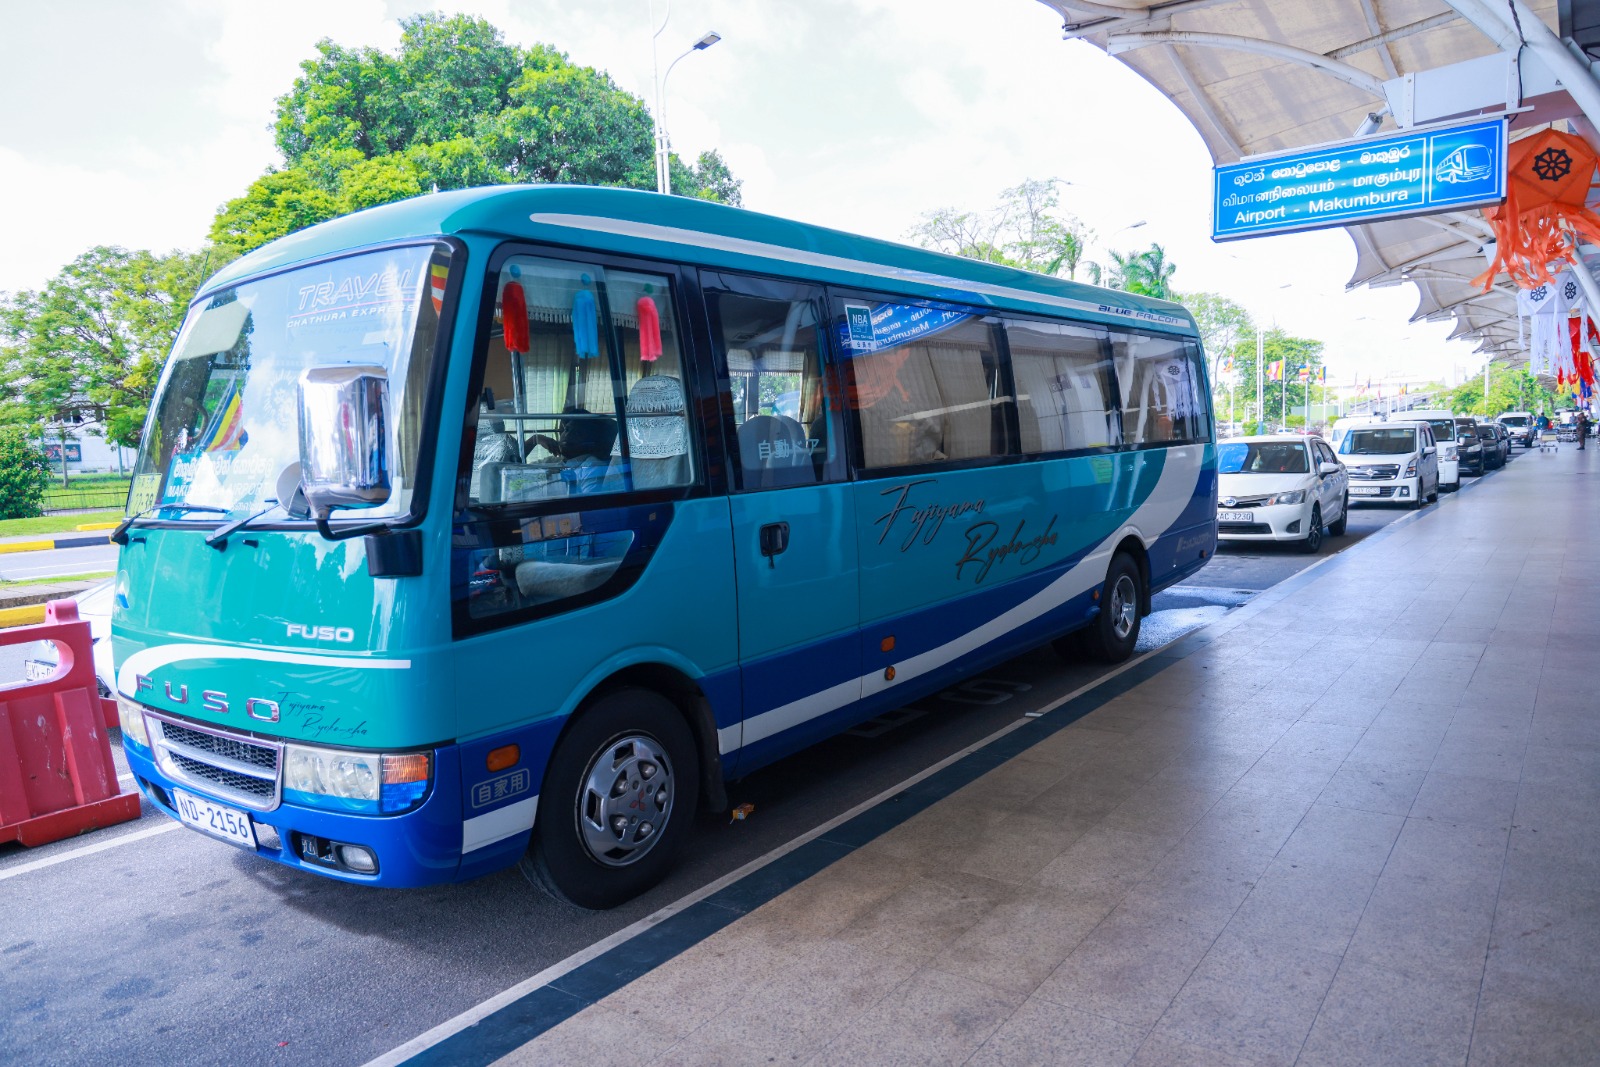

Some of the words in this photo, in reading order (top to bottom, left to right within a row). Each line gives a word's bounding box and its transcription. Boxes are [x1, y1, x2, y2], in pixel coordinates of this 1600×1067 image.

[1234, 205, 1286, 224] Airport
[1308, 190, 1409, 214] Makumbura
[298, 269, 417, 311] TRAVEL
[286, 311, 348, 329] CHATHURA
[351, 303, 416, 318] EXPRESS
[852, 314, 868, 324] NBA
[1098, 304, 1132, 316] BLUE
[1136, 311, 1178, 324] FALCON
[758, 438, 820, 461] 自動ドア
[874, 479, 985, 552] Fujiyama
[286, 622, 355, 642] FUSO
[135, 673, 281, 723] FUSO
[479, 773, 524, 803] 自家用
[178, 796, 248, 839] ND-2156
